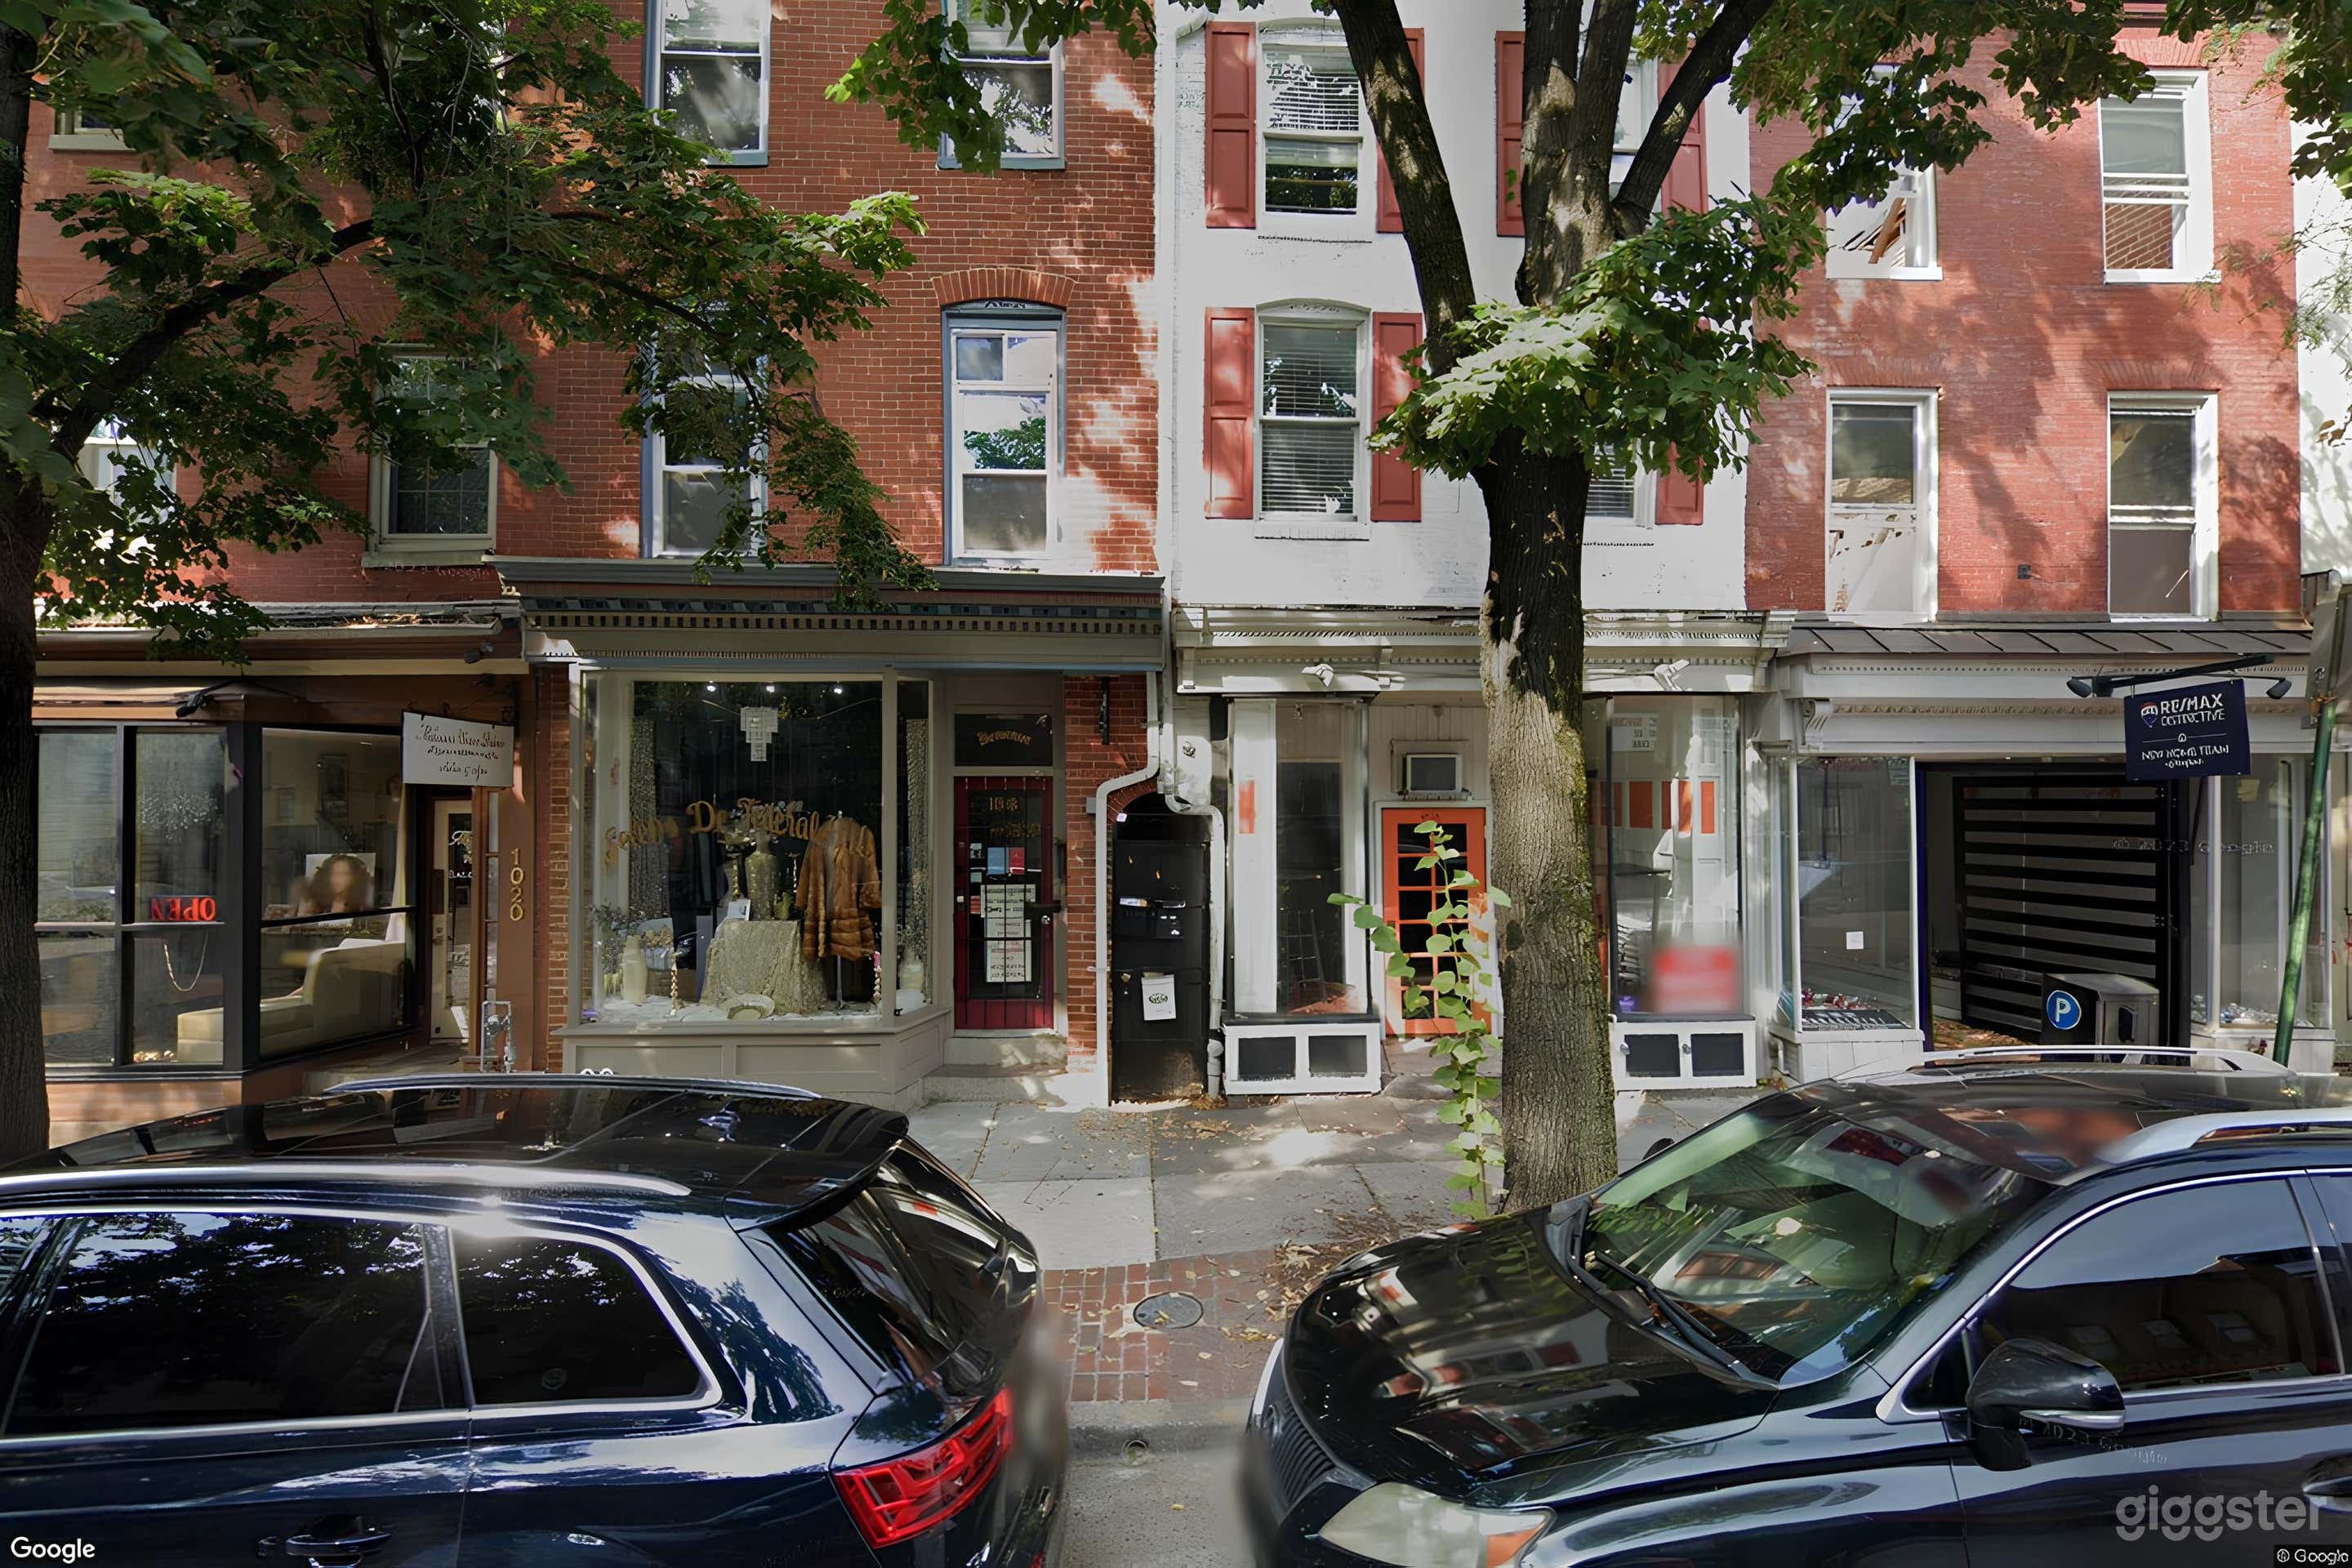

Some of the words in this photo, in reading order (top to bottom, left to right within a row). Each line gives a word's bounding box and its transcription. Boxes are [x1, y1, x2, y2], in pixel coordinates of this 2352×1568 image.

[2160, 693, 2224, 715] RE/MAX
[510, 848, 524, 921] 1020
[2055, 997, 2072, 1022] P
